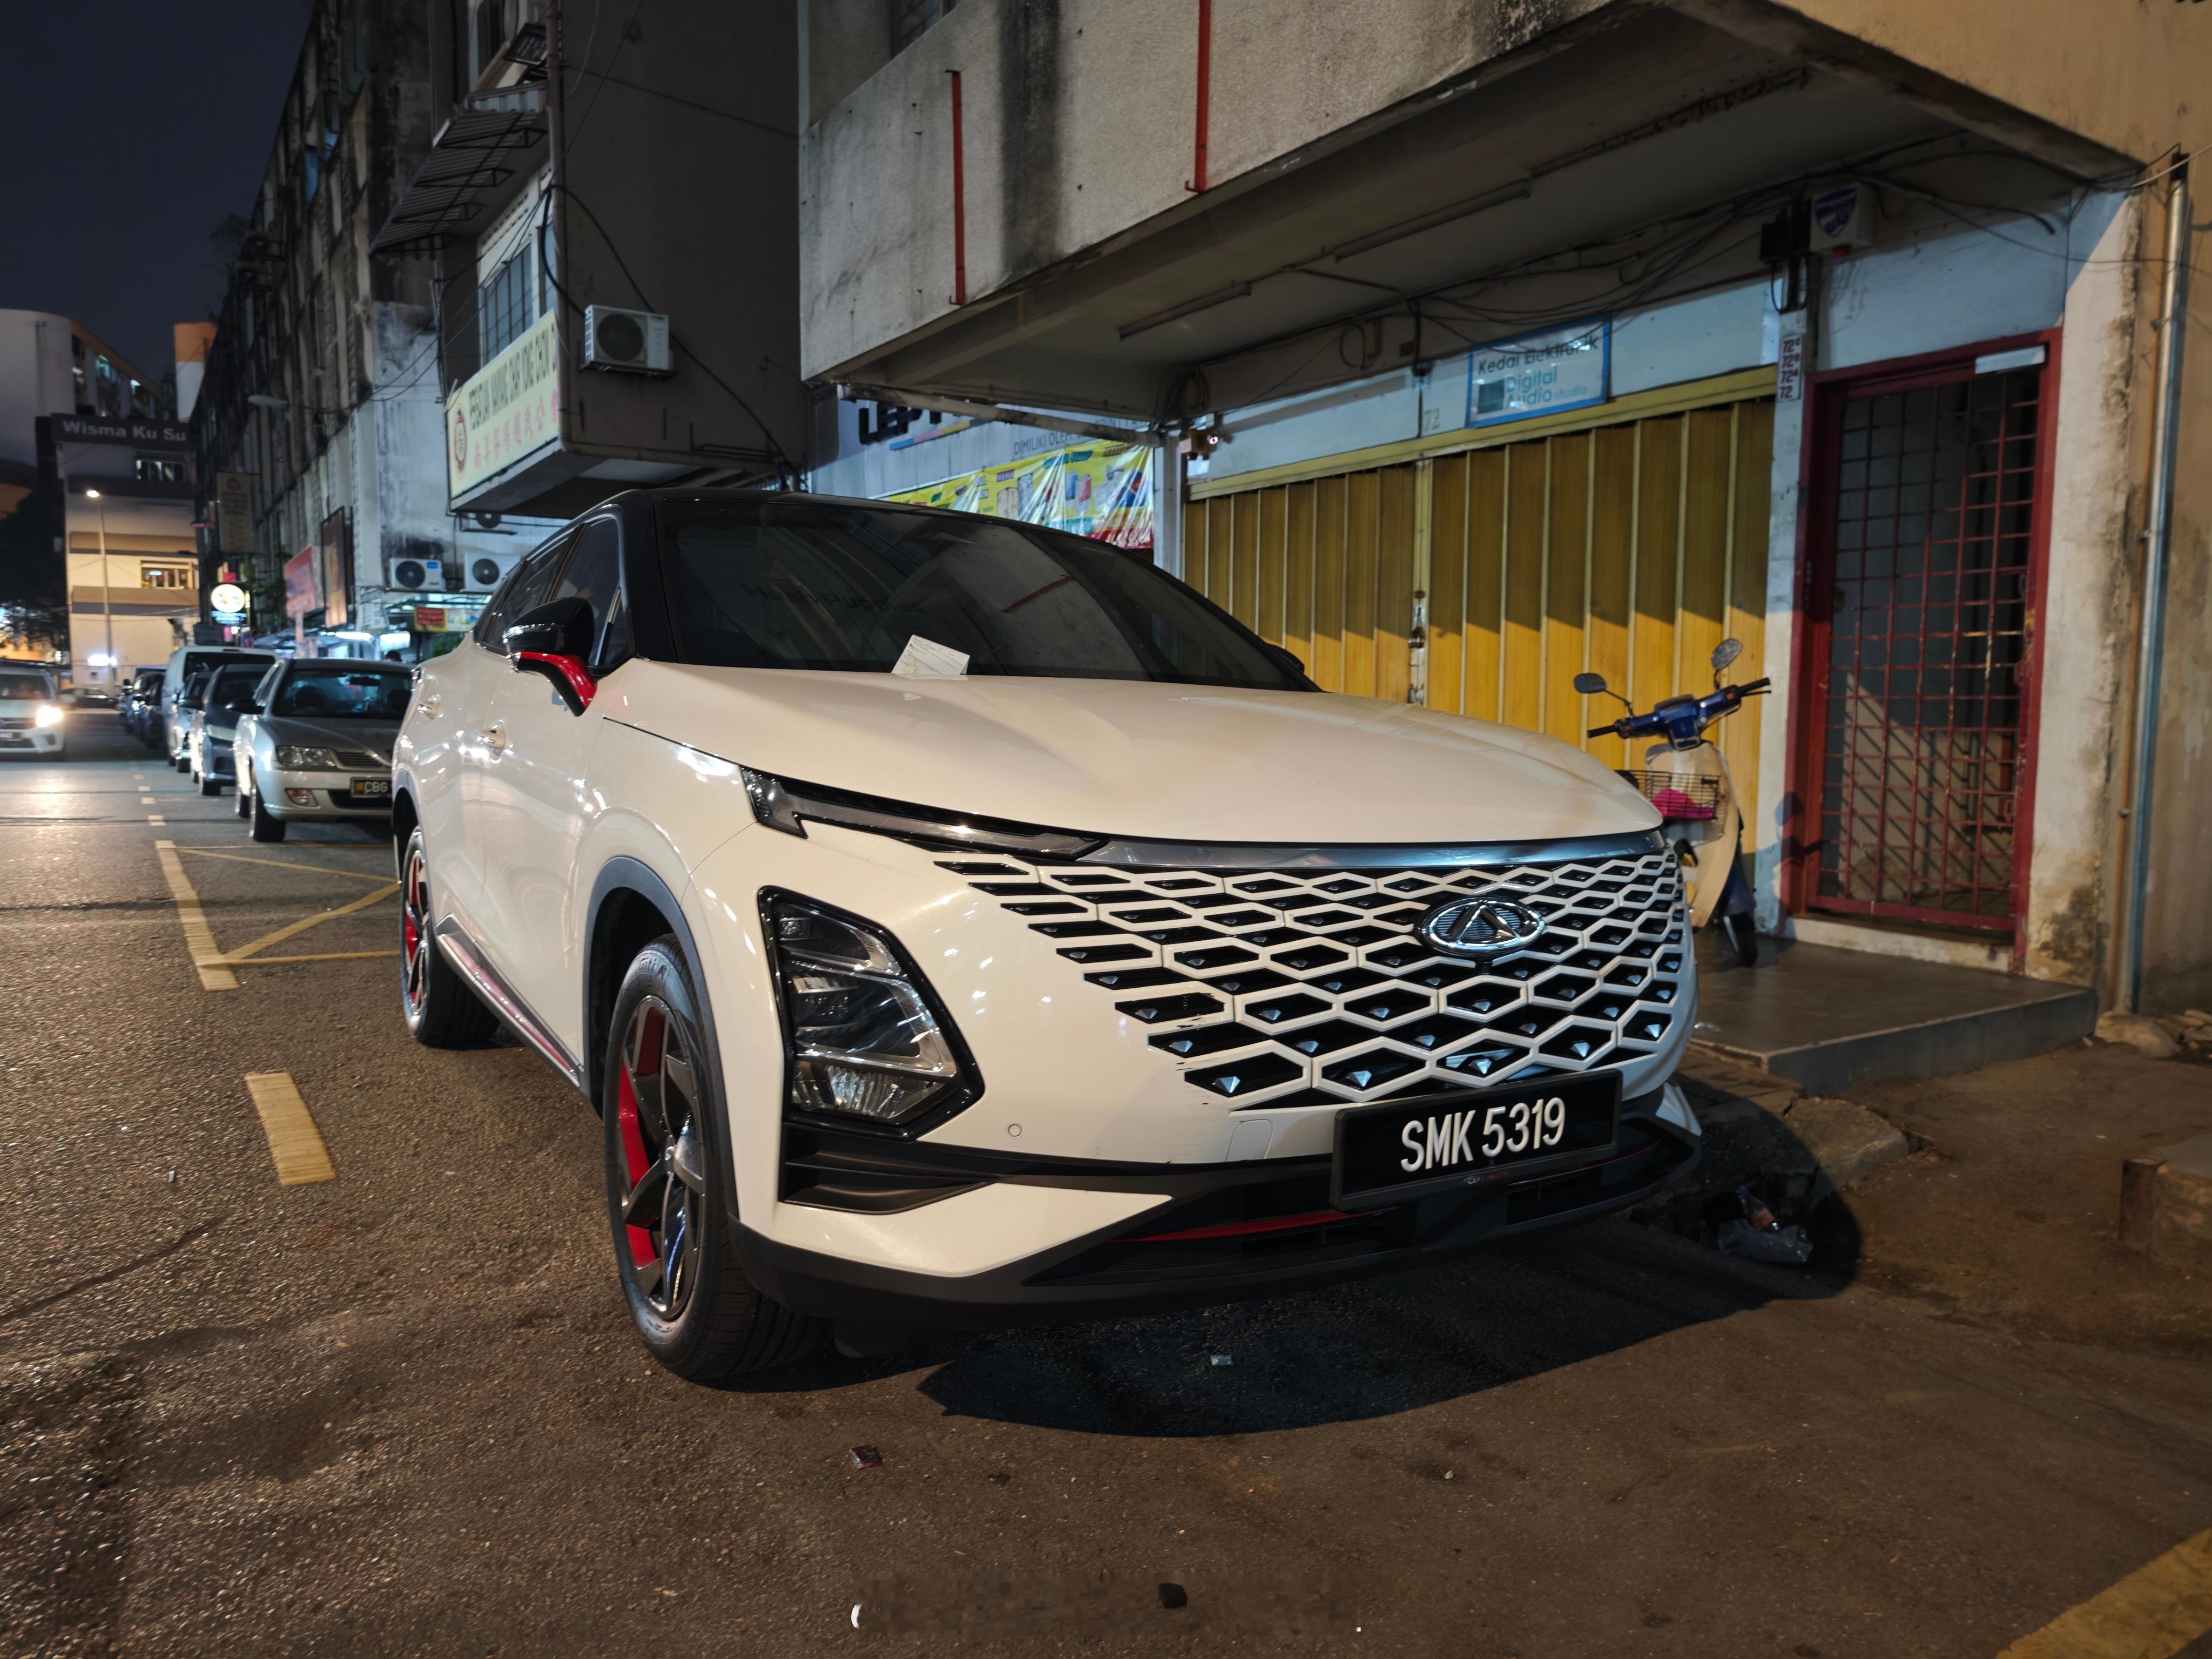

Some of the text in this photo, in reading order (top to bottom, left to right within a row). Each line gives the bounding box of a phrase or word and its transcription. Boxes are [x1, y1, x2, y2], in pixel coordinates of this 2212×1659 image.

[1479, 354, 1520, 375] Kedai
[1506, 365, 1557, 393] Digital
[1779, 385, 1792, 399] 72
[63, 421, 127, 438] Wisma
[132, 426, 158, 440] Ku
[1015, 434, 1047, 455] DIMILIKI
[1401, 1097, 1566, 1172] SMK 5319
